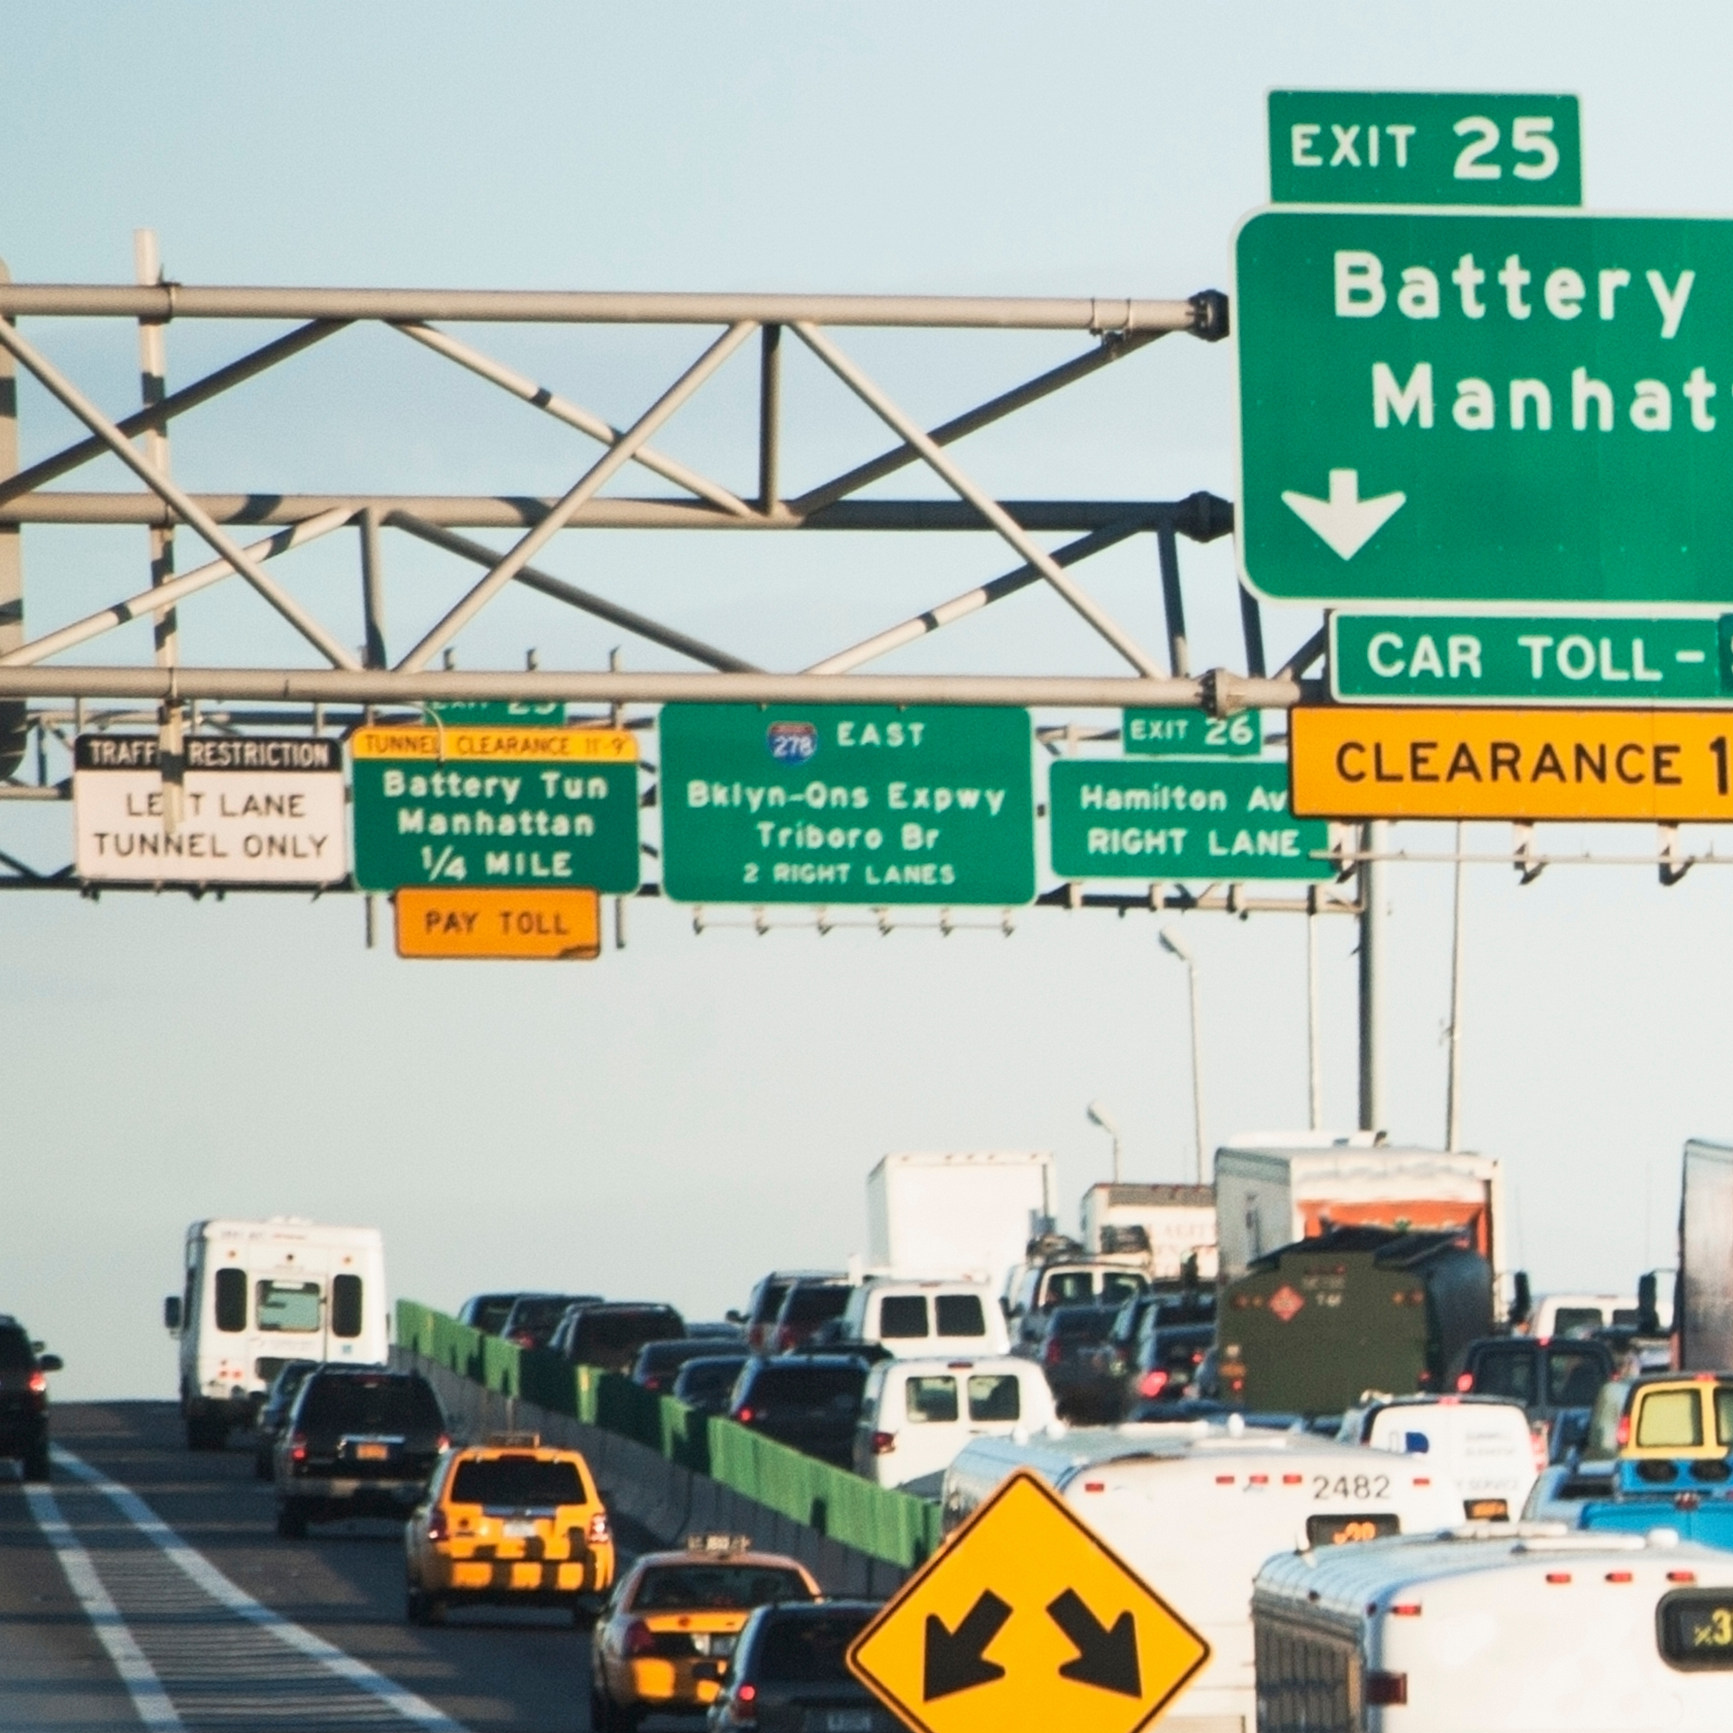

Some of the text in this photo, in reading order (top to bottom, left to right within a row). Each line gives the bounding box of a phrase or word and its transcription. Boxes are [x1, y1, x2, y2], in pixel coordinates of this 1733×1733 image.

[1290, 115, 1561, 181] EXIT 25
[1333, 249, 1697, 339] Battery
[1366, 632, 1482, 680] CAR
[772, 720, 926, 759] 278 EAST
[1129, 714, 1255, 746] EXIT 26
[90, 740, 329, 767] TRAFF RESTRICTION
[456, 735, 570, 756] CLEARANCE
[1335, 740, 1683, 787] CLEARANCE
[382, 769, 609, 805] Battery Tun
[887, 781, 1006, 817] Expwy
[1080, 782, 1288, 812] Hamilton Av
[126, 792, 307, 818] LET LANE
[397, 807, 596, 837] Manhattan
[755, 819, 941, 850] Triboro Br
[93, 832, 329, 859] TUNNEL ONLY
[1087, 826, 1301, 857] RIGHT LANE
[485, 851, 573, 878] MILE
[743, 862, 956, 886] 2 RIGHT LANES
[424, 908, 570, 936] PAY TOLL
[1312, 1474, 1390, 1501] 2482
